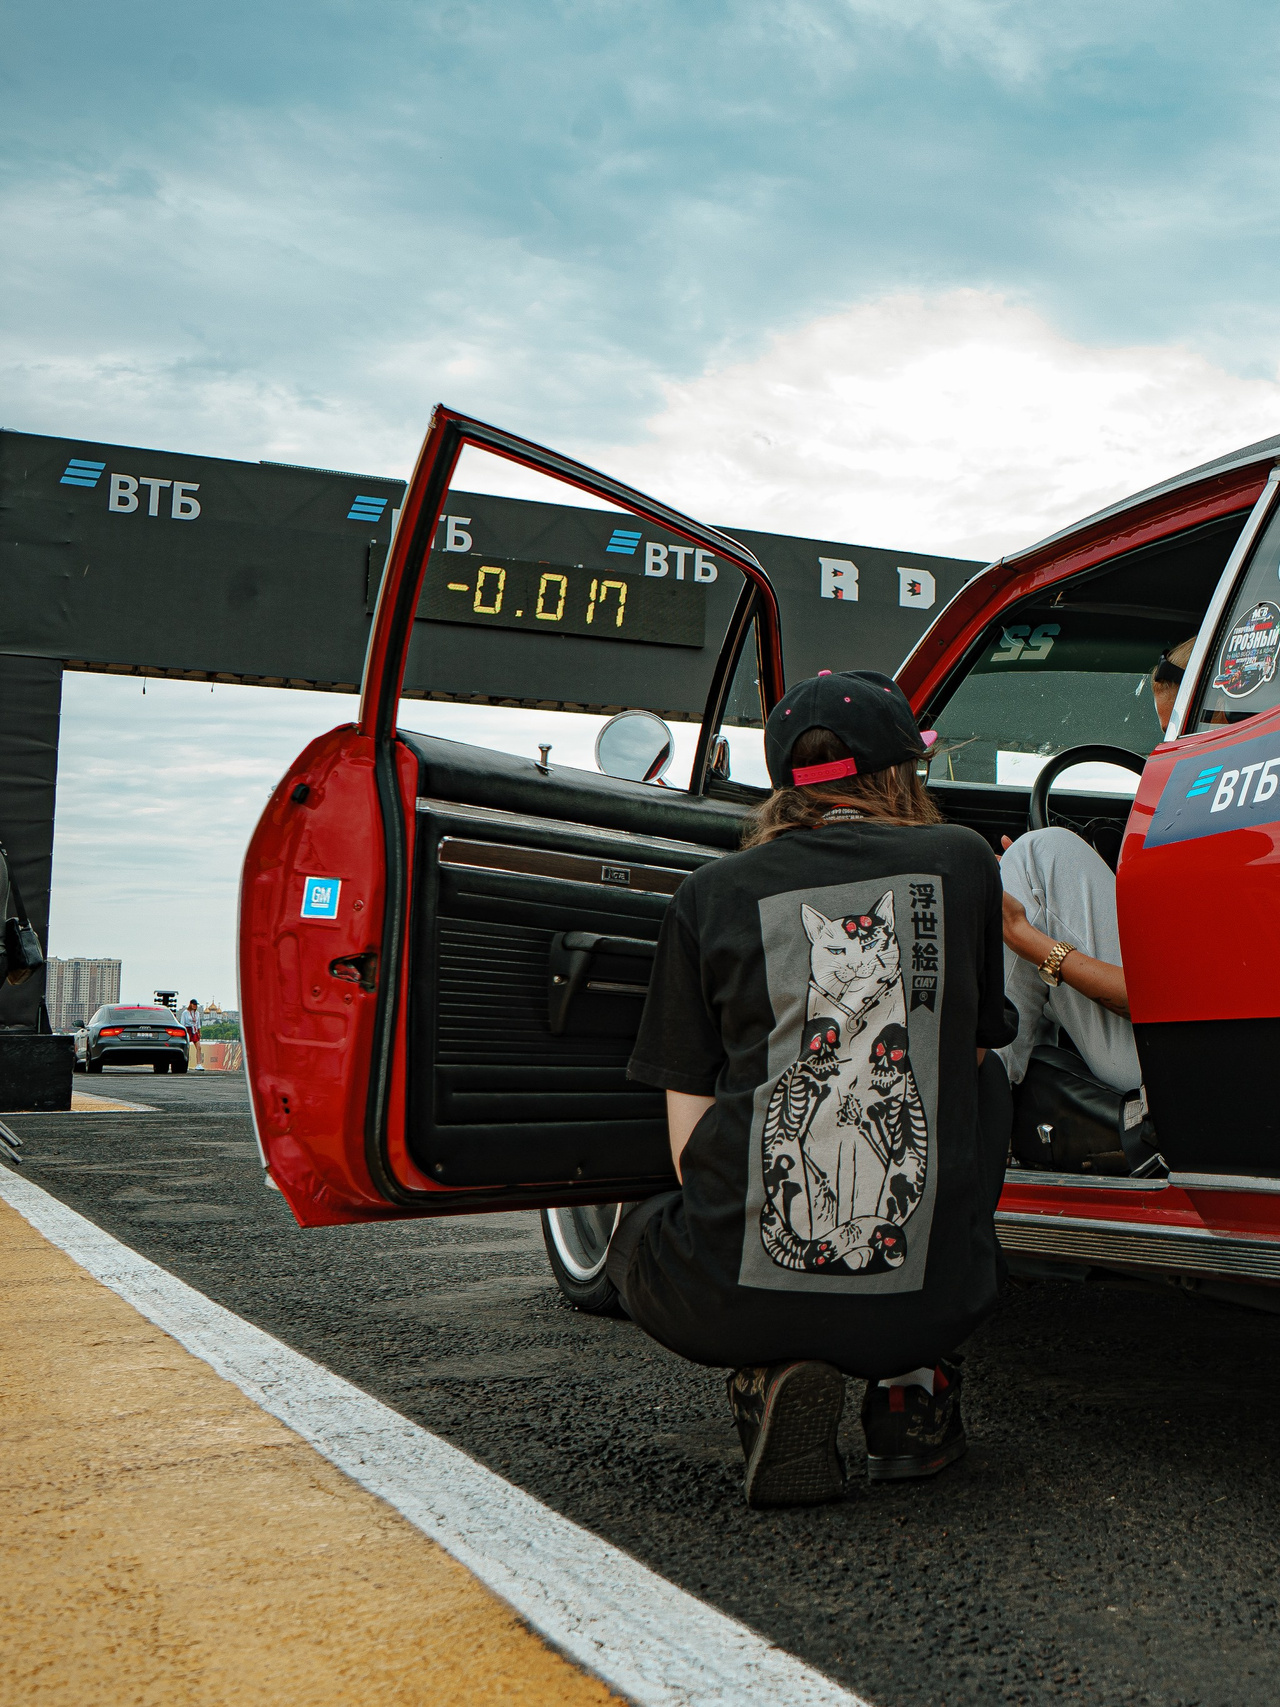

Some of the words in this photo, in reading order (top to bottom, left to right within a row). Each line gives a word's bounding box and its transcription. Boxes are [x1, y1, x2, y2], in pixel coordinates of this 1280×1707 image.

[108, 472, 202, 521] ВТБ
[643, 542, 719, 584] ВТБ
[447, 565, 628, 628] -0.017
[990, 623, 1061, 662] SS
[1228, 625, 1280, 653] ГРОЗНЫЙ
[311, 886, 331, 903] GM
[908, 883, 939, 972] 浮世絵
